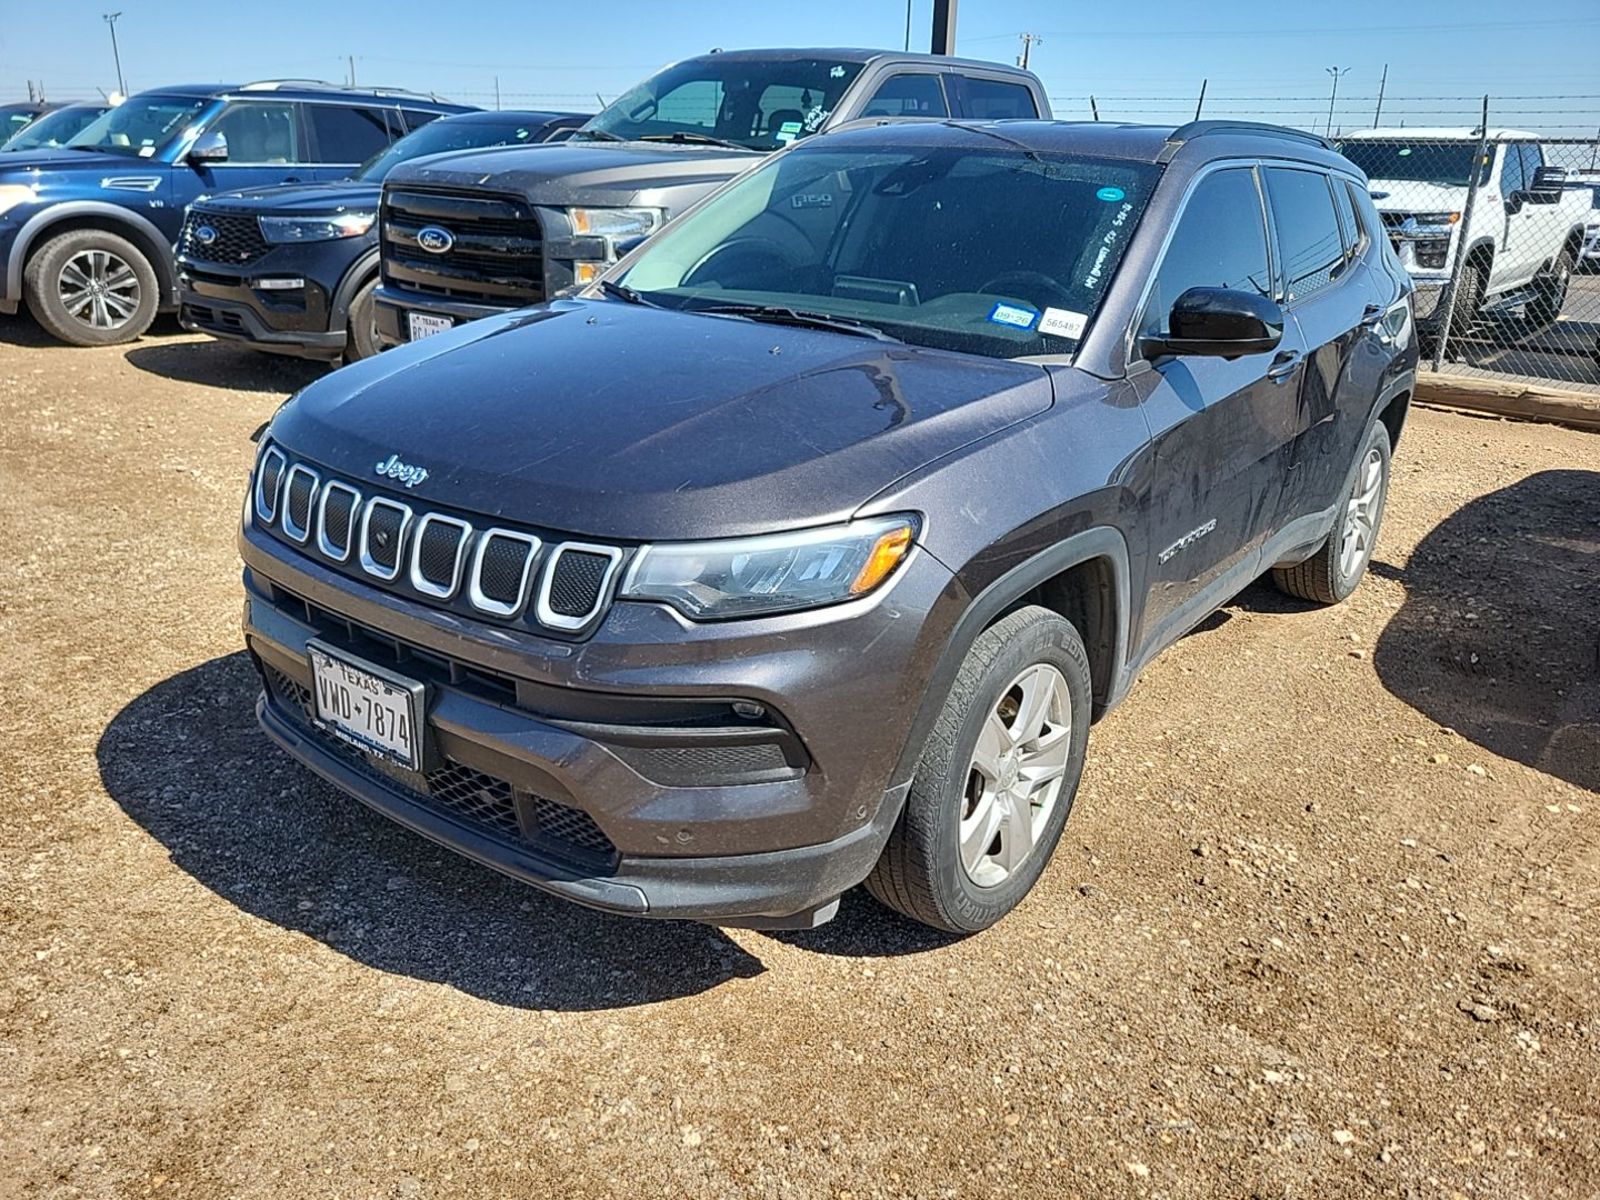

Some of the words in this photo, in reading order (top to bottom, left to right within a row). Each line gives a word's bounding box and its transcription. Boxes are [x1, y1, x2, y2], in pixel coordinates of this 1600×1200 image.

[423, 231, 443, 248] Ford
[375, 454, 429, 488] Jeep
[340, 665, 379, 695] TEXAS
